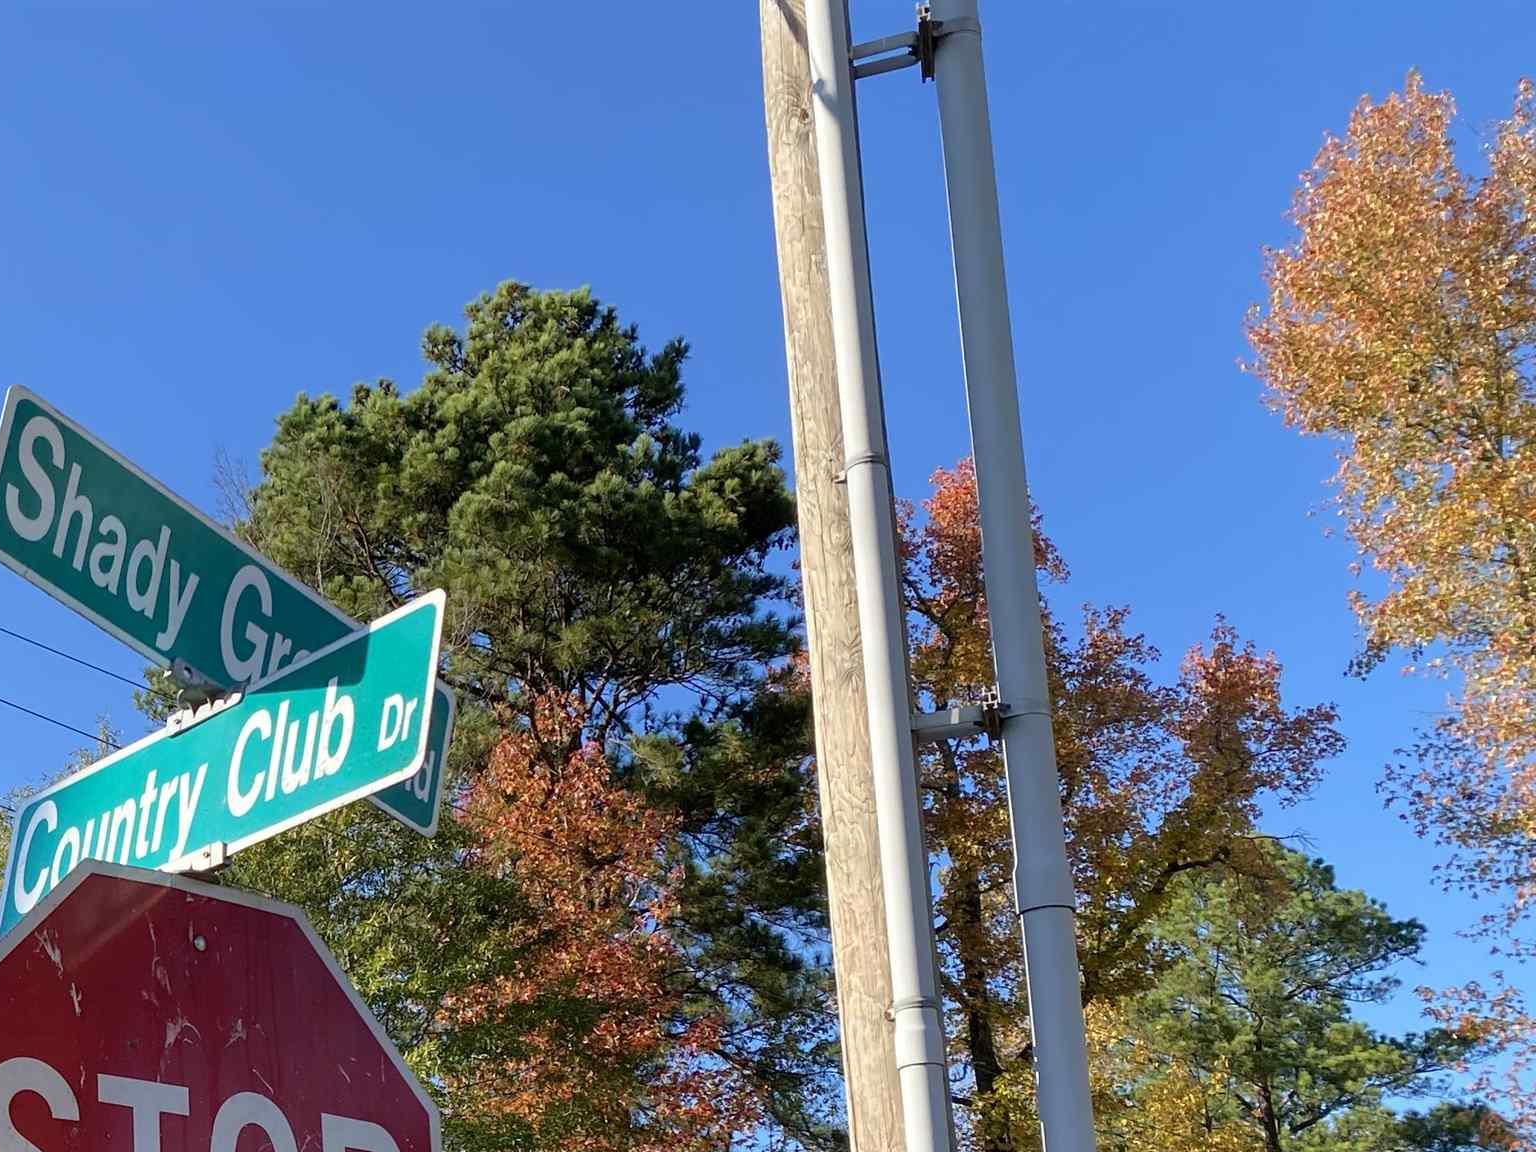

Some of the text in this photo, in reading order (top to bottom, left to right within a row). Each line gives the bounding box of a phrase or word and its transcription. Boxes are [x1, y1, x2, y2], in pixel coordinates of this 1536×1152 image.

[5, 415, 436, 803] Shady Gr d
[14, 675, 419, 915] Country Club Dr
